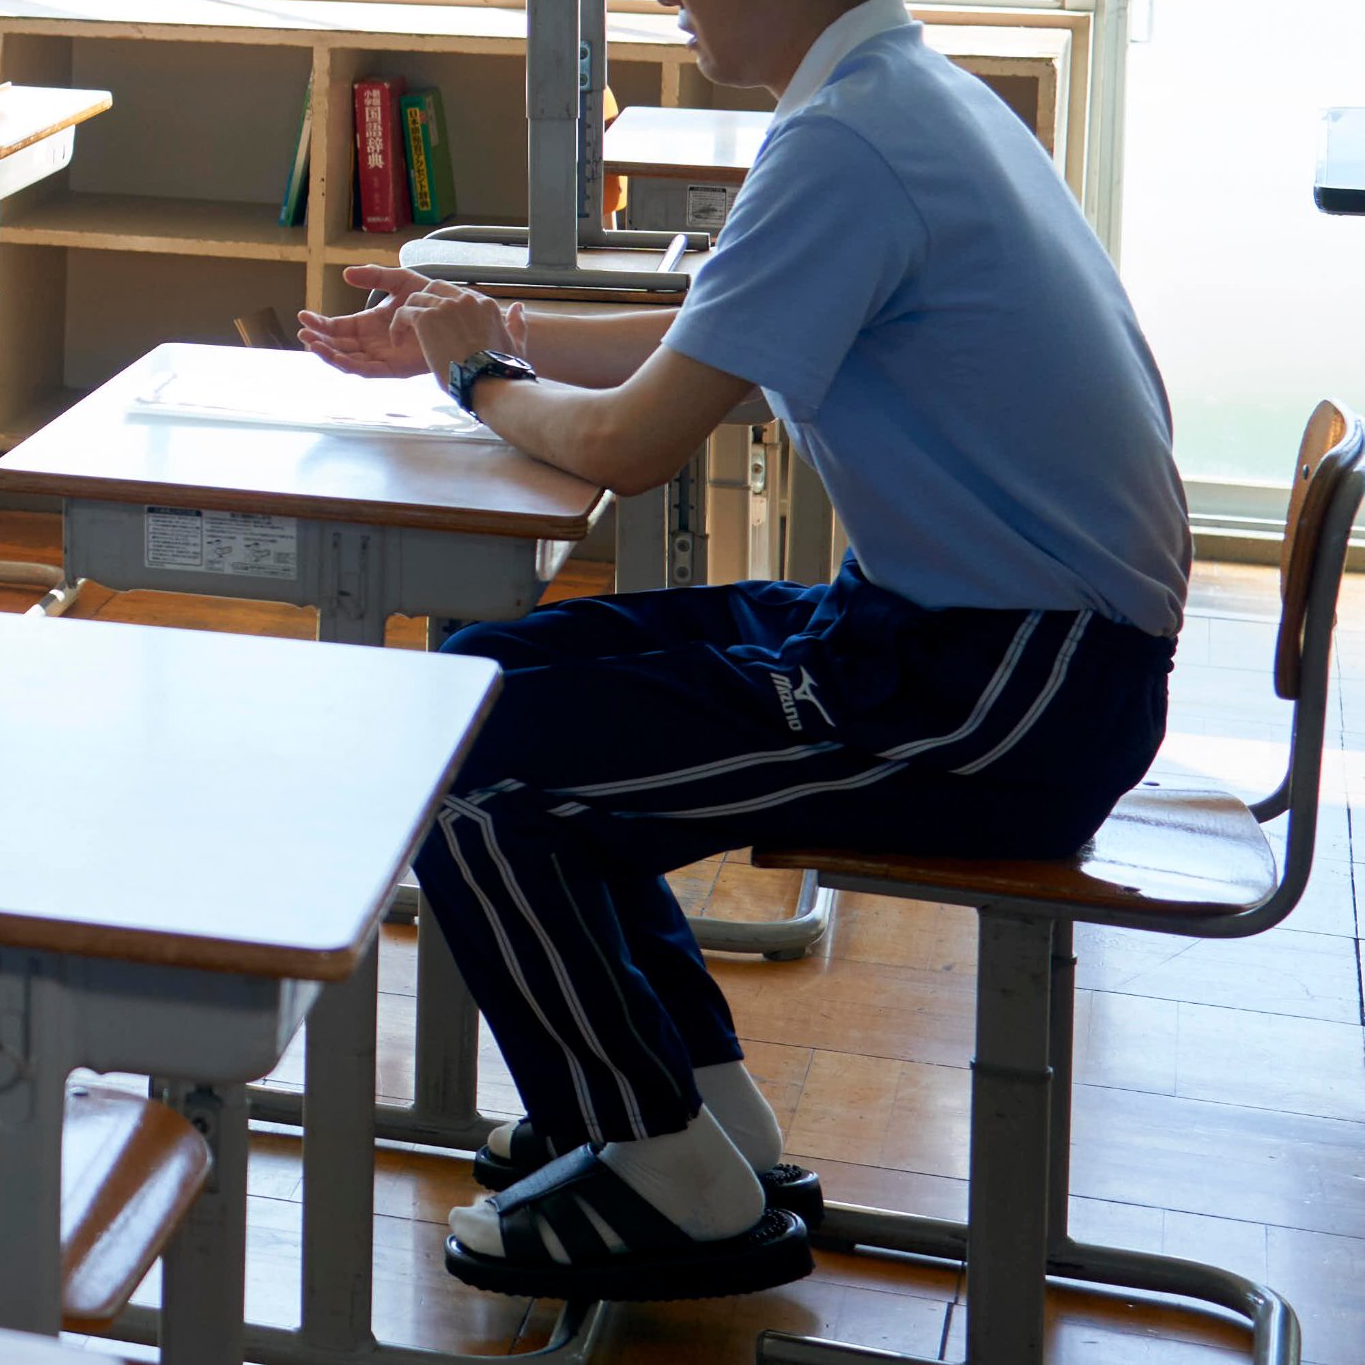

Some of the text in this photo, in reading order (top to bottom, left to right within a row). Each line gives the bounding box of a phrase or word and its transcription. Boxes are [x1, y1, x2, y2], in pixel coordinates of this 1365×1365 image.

[364, 106, 385, 169] 国語辞典
[770, 672, 803, 731] MIZUNO
